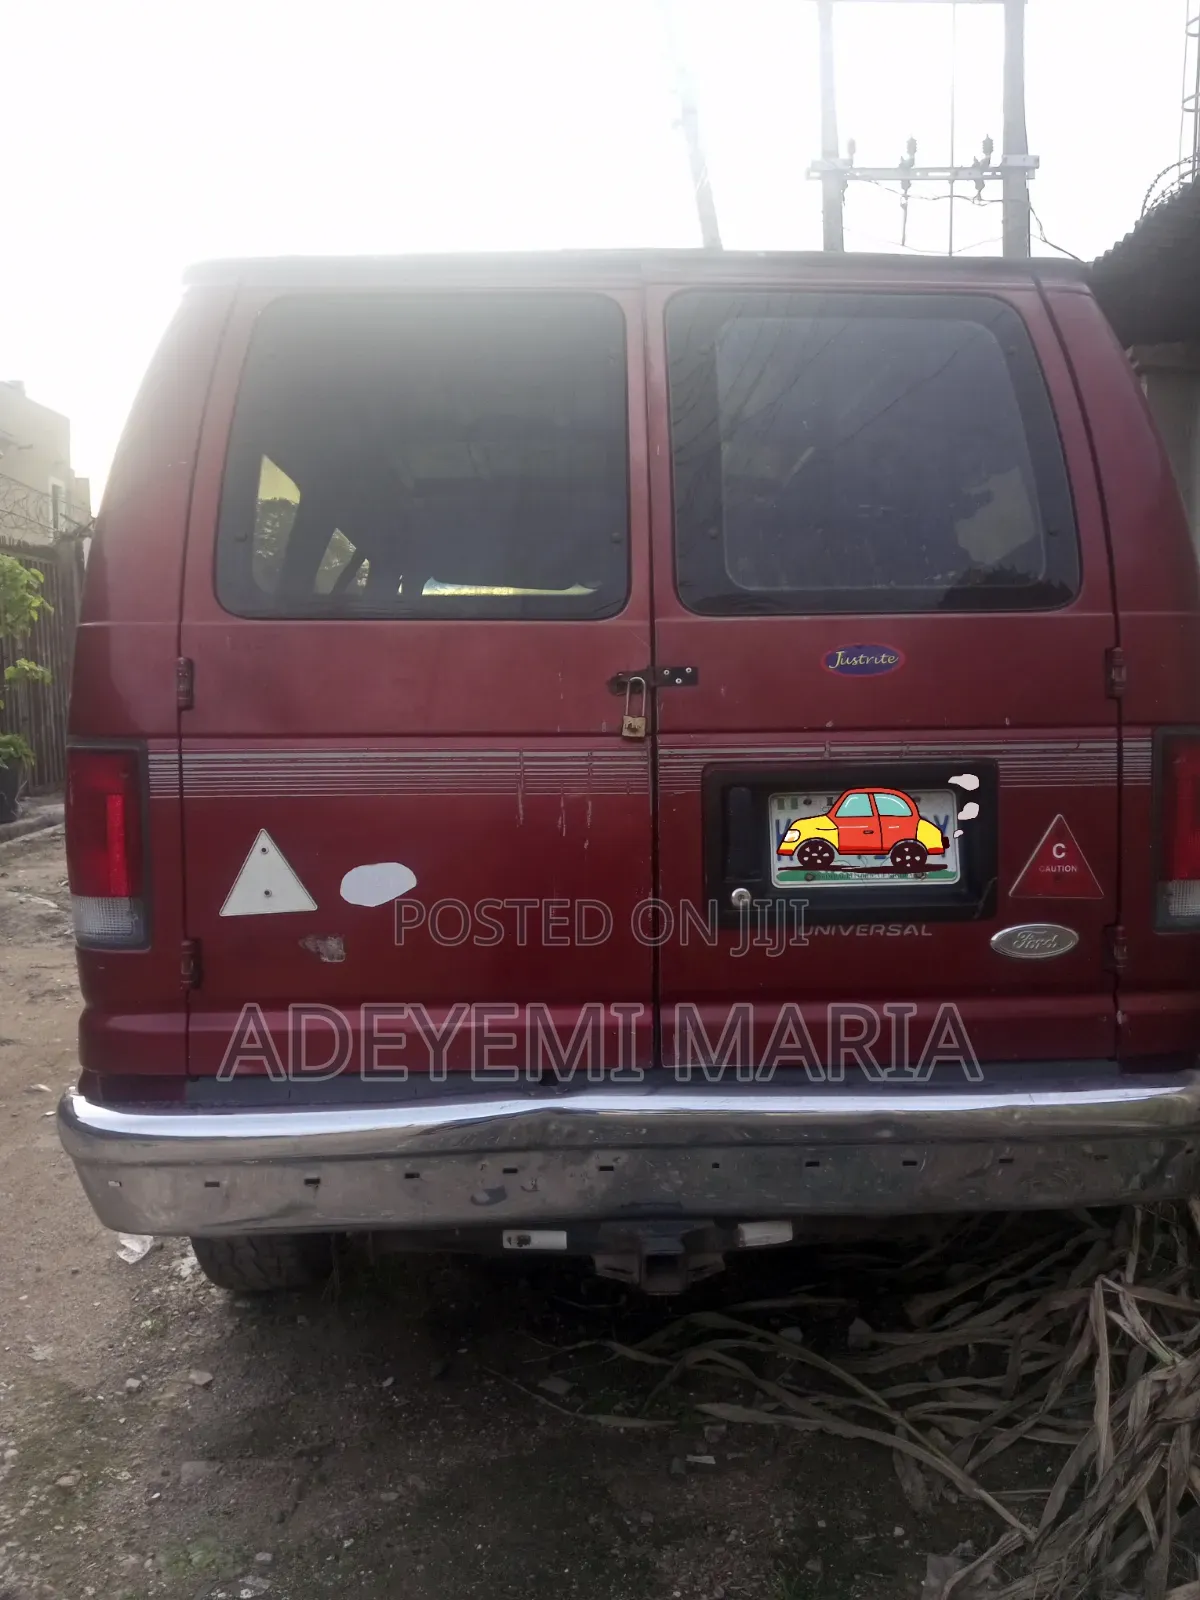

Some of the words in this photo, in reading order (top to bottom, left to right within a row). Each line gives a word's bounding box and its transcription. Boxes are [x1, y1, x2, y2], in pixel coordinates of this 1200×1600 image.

[828, 650, 899, 669] Justrite
[1052, 842, 1066, 859] C
[1038, 864, 1078, 873] CAUTION
[798, 923, 933, 937] UNIVERSAL
[1012, 930, 1059, 950] Ford
